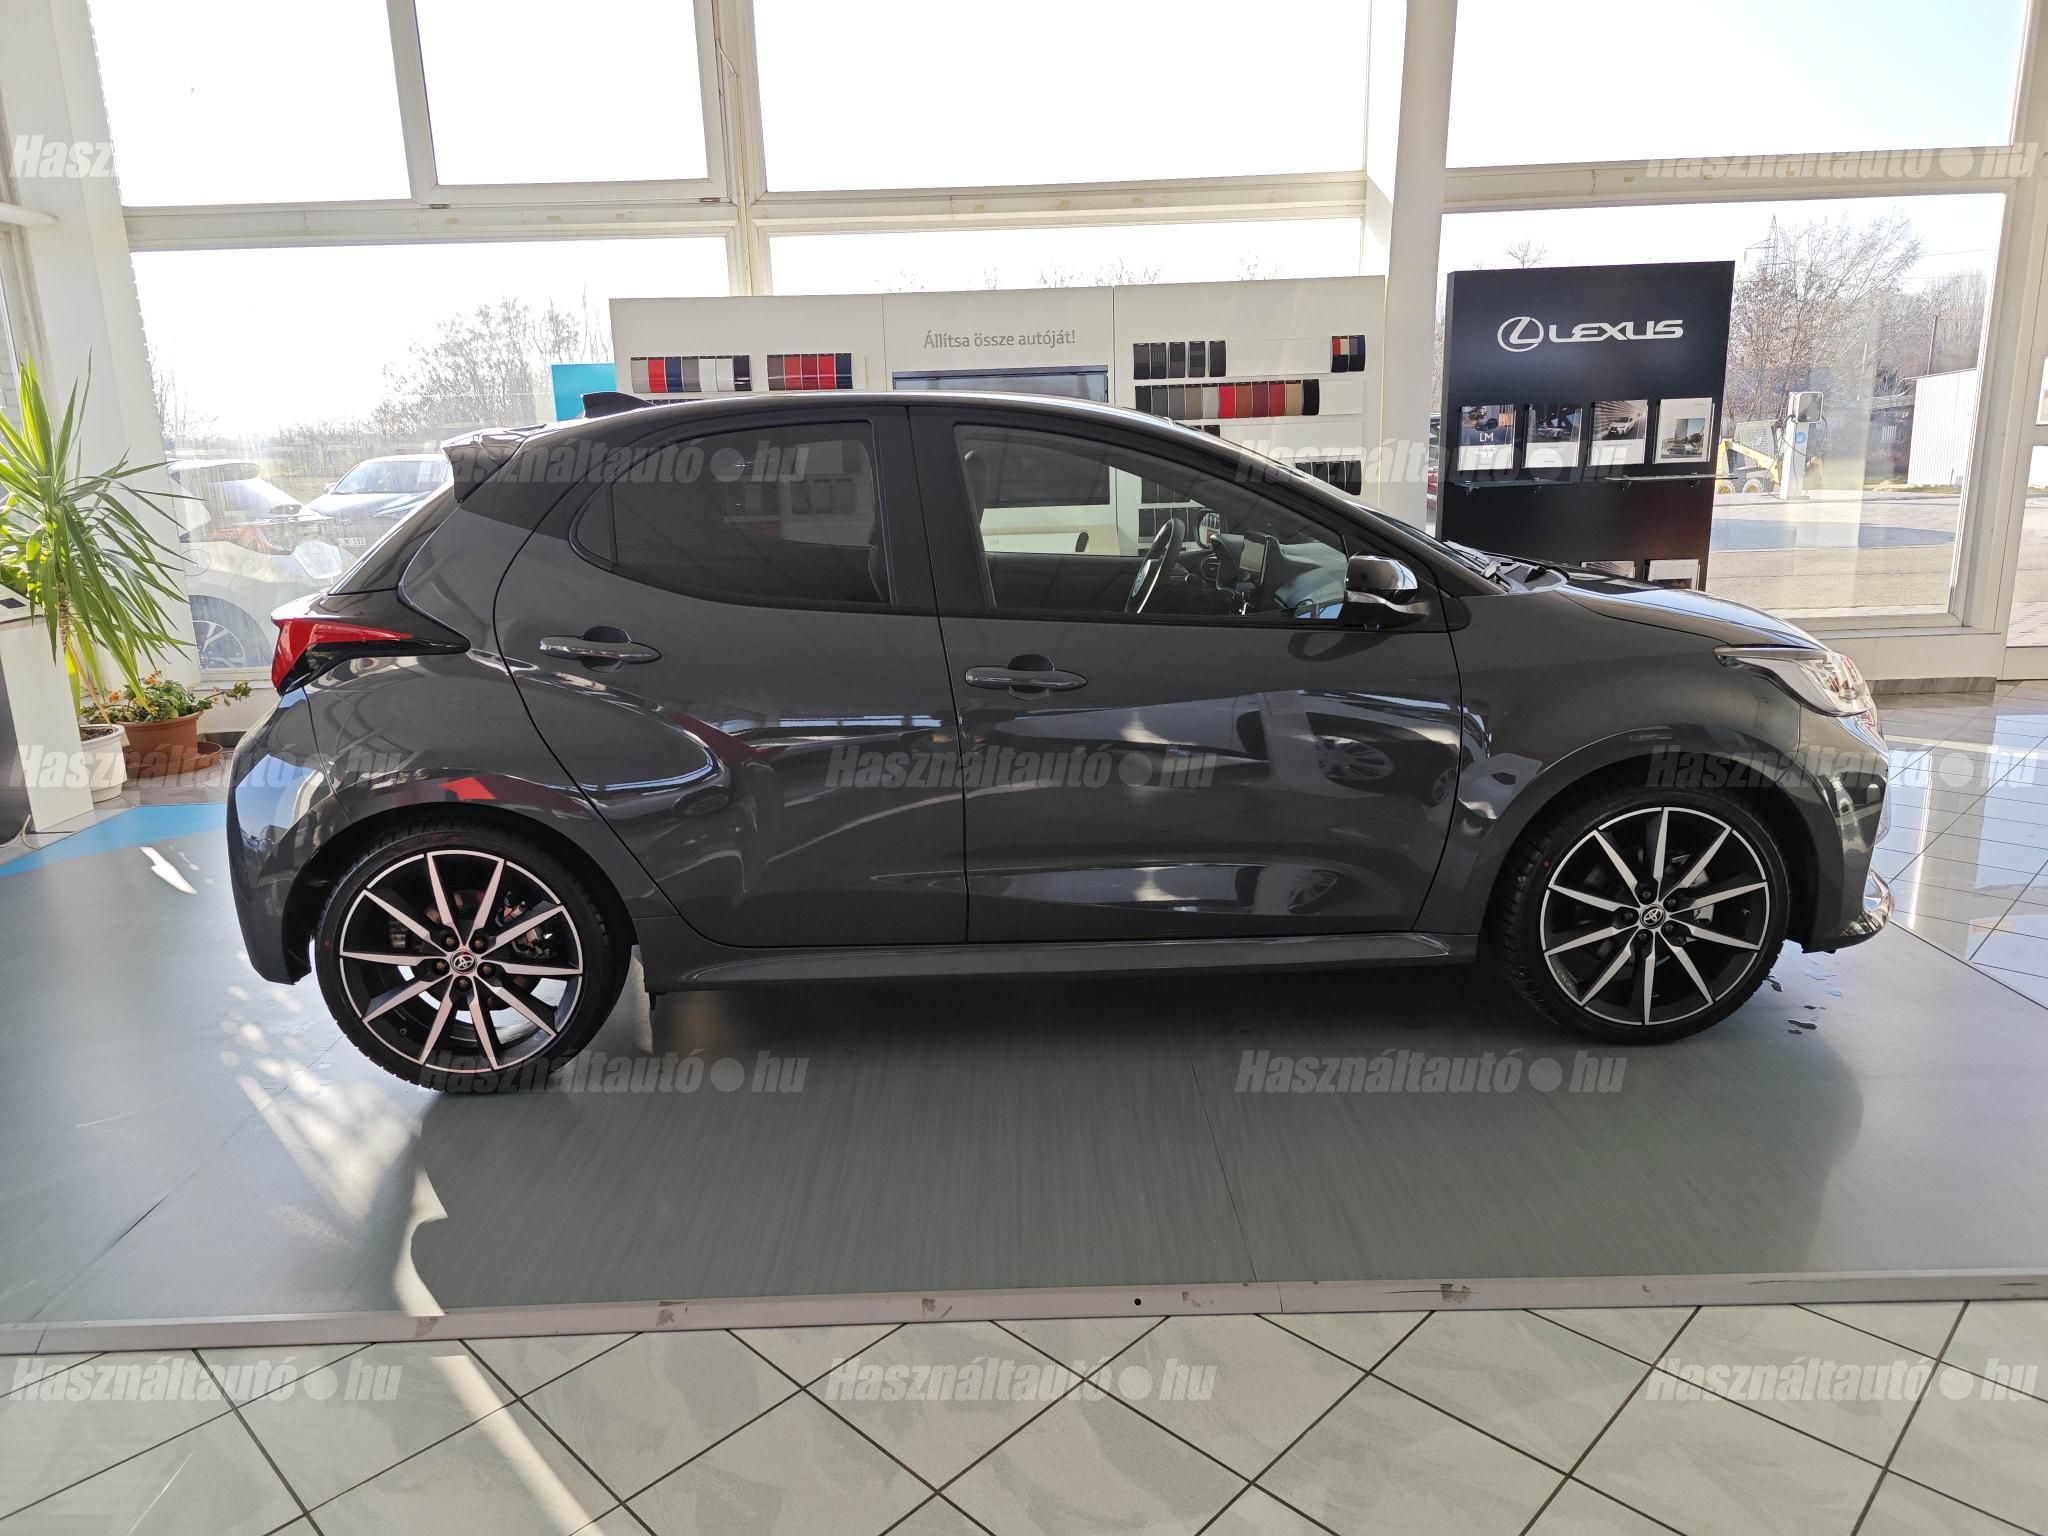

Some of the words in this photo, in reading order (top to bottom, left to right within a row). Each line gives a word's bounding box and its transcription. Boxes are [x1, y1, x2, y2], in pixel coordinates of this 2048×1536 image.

[924, 330, 970, 349] Állítsa
[974, 332, 1015, 347] össze
[1018, 329, 1076, 349] autóját!
[1548, 319, 1684, 343] LEXUS
[1479, 432, 1494, 442] LM
